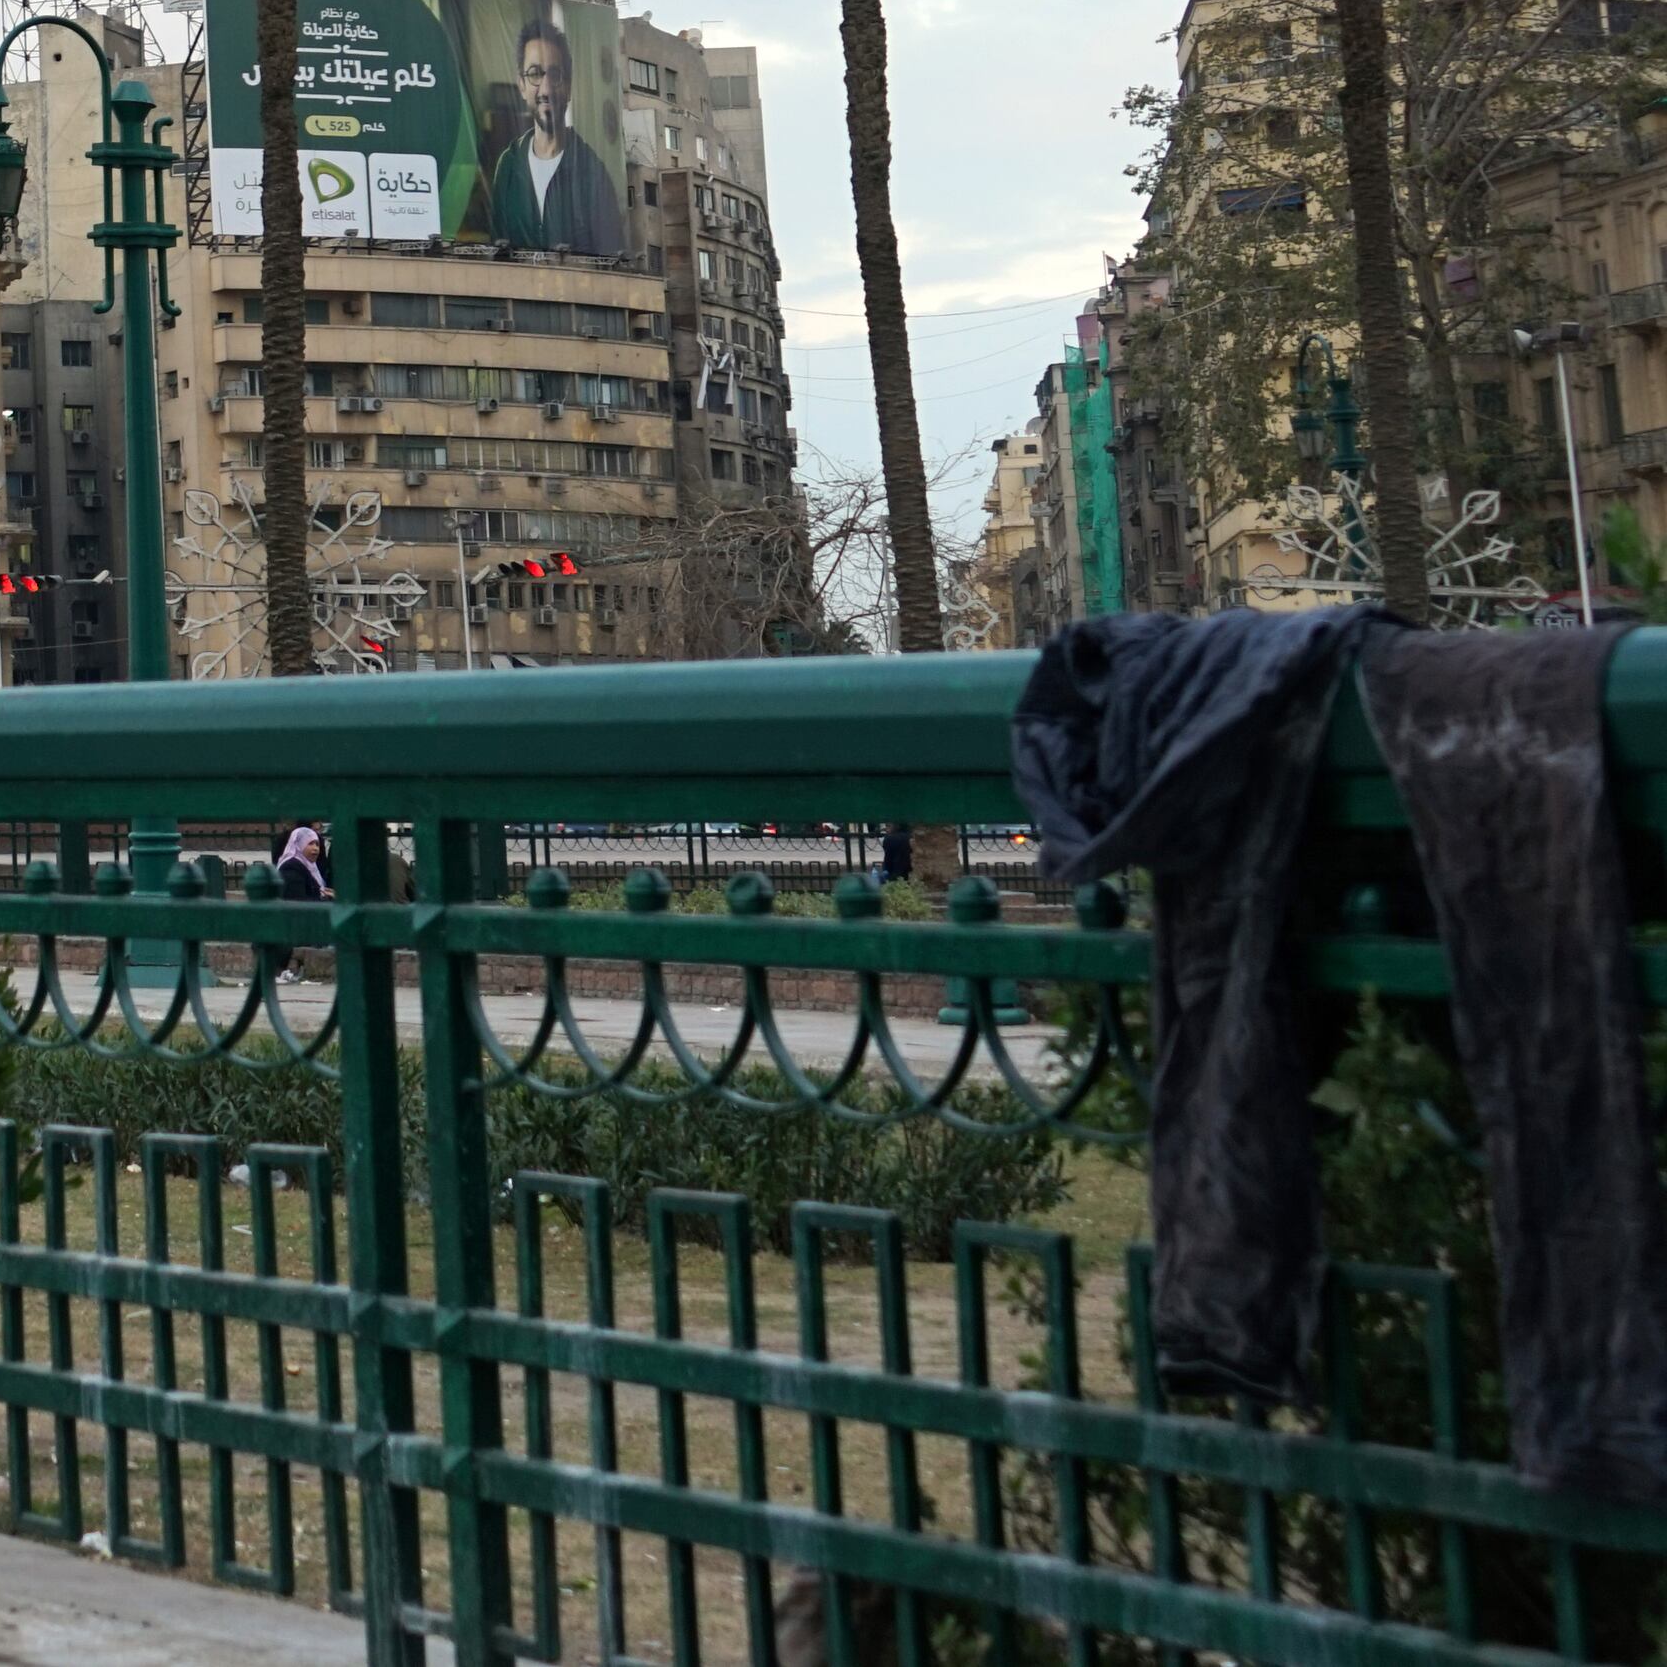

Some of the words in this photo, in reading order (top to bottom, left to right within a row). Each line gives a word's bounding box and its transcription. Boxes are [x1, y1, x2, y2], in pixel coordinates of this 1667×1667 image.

[320, 8, 344, 21] نظام
[344, 11, 360, 22] مع
[302, 21, 343, 41] للعيلة
[344, 22, 379, 42] حكاية
[320, 59, 389, 91] عيلتك
[394, 62, 436, 92] كلم
[329, 120, 352, 132] 525
[361, 121, 387, 133] كلم
[376, 168, 432, 199] حكاية
[312, 209, 357, 222] etisalat
